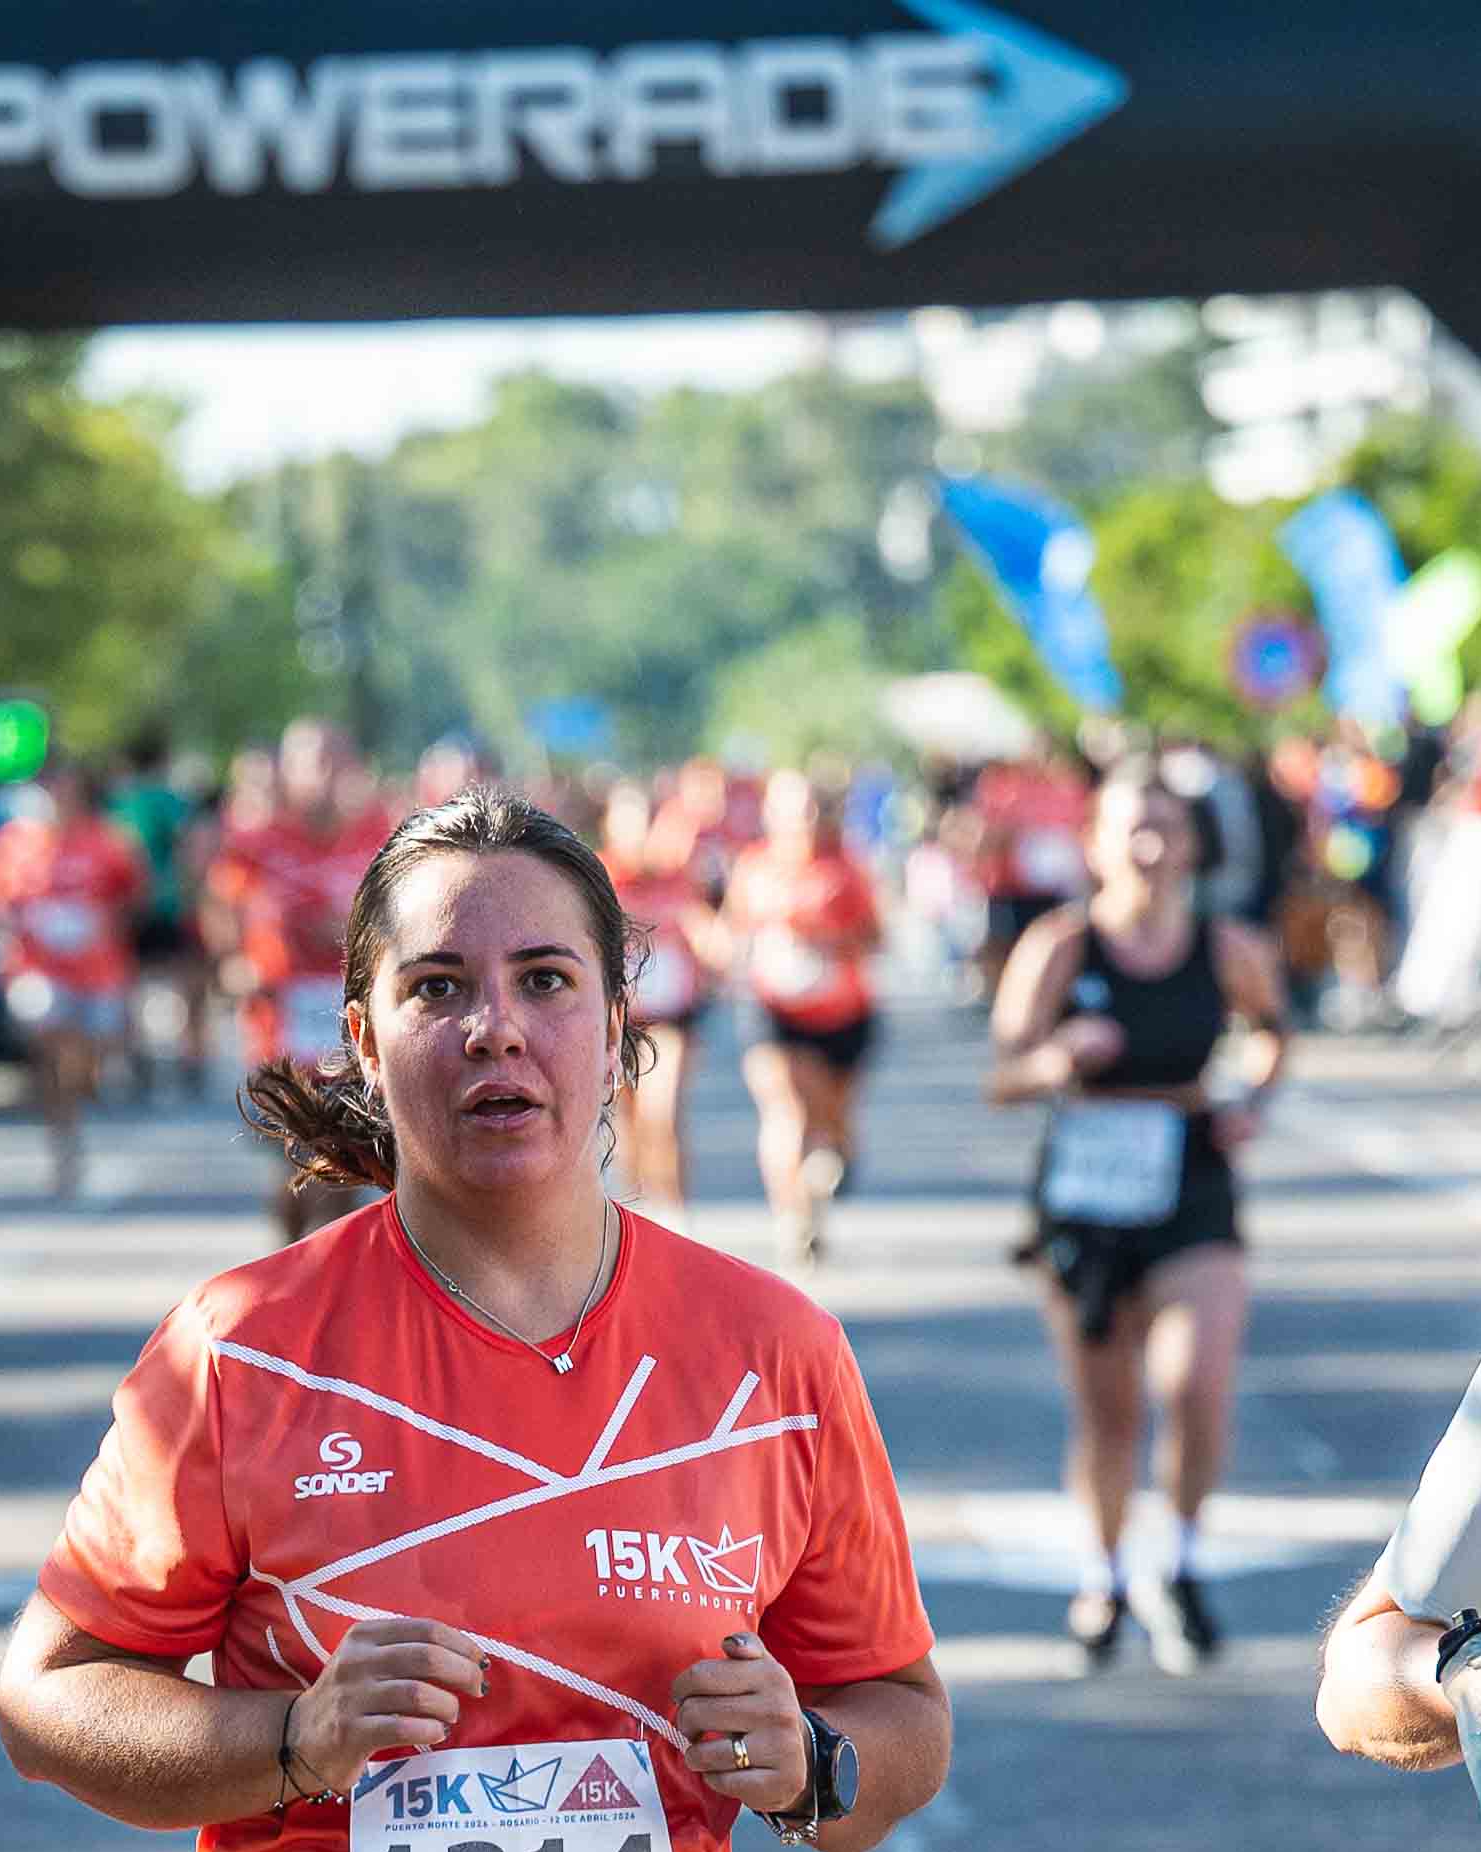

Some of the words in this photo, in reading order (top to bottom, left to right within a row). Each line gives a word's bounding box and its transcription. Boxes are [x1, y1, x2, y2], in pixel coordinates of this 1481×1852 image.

[585, 1528, 690, 1586] 15K
[597, 1583, 692, 1605] PUERTO
[699, 1592, 756, 1617] NORTE
[385, 1774, 474, 1820] 15K
[577, 1780, 623, 1804] 15K
[385, 1822, 425, 1833] PUERTO
[427, 1820, 460, 1831] NORTE
[499, 1816, 540, 1828] ROSARIO
[564, 1813, 576, 1824] DE
[579, 1812, 607, 1824] ABRIL
